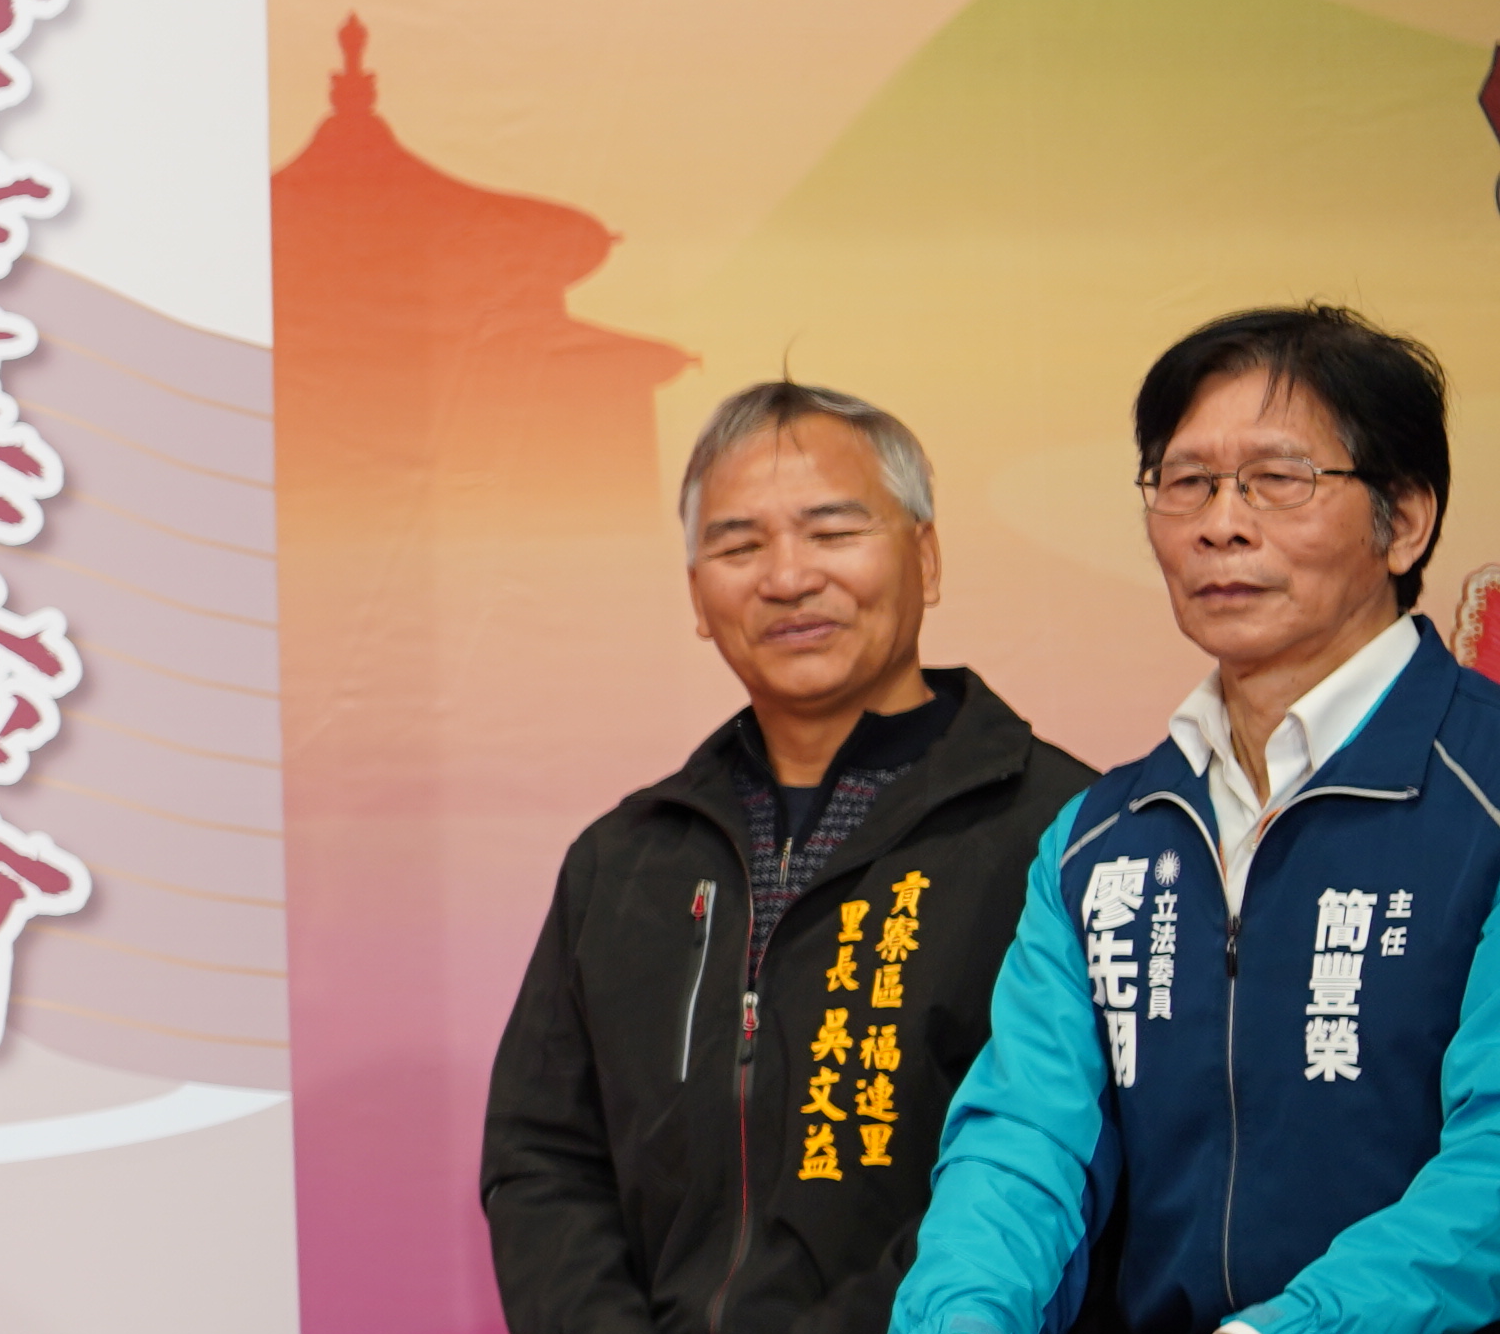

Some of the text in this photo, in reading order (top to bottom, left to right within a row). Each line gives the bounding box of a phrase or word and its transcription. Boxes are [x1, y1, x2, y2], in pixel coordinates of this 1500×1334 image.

[826, 900, 871, 992] 里長
[871, 870, 930, 1008] 貢寮區
[1148, 889, 1178, 1021] 立法委員
[1304, 887, 1378, 1082] 簡豐榮
[1379, 888, 1414, 957] 主任
[798, 1007, 853, 1181] 吳文益
[854, 1024, 900, 1166] 福連里
